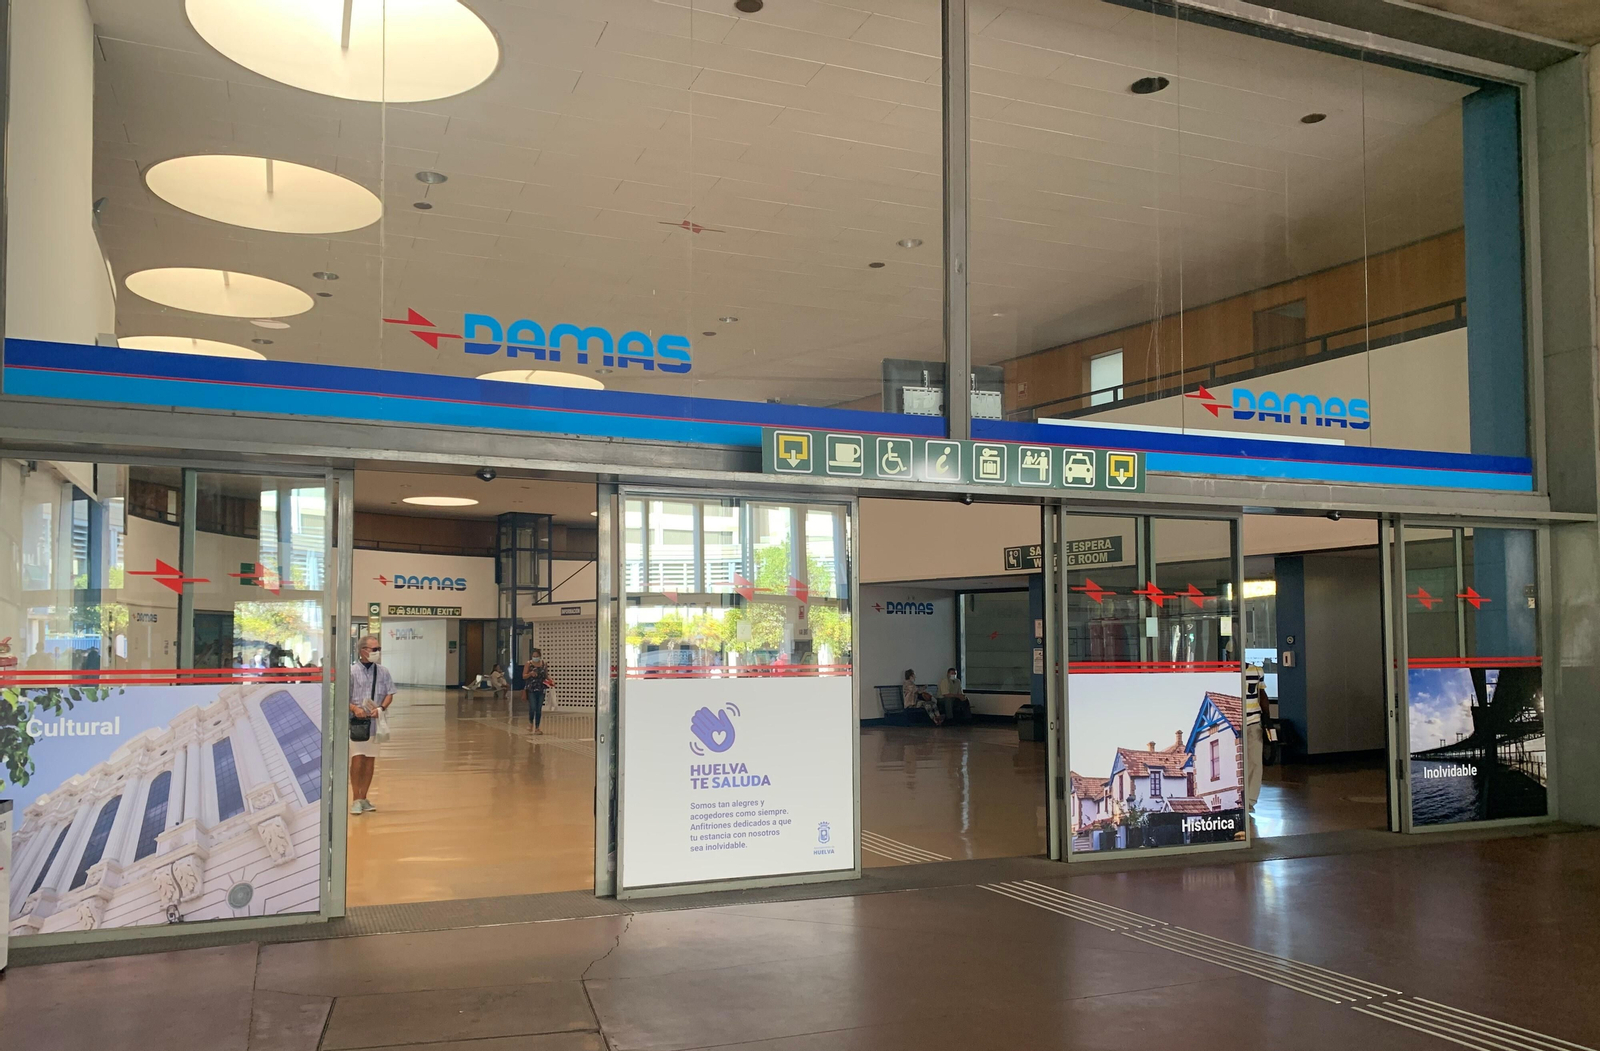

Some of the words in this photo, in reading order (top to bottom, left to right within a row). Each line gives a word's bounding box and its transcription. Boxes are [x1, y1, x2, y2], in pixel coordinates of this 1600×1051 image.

[464, 313, 692, 374] DAMAS
[1232, 388, 1371, 430] DAMAS
[1072, 538, 1112, 552] ESPERA
[1078, 552, 1108, 564] ROOM
[394, 574, 467, 591] DAMAS
[406, 607, 432, 615] SALIDA
[886, 601, 934, 615] DAMAS
[25, 715, 120, 738] Cultural
[690, 763, 748, 776] HUELVA
[1423, 763, 1478, 779] Inolvidable
[690, 777, 709, 789] TE
[712, 775, 771, 789] SALUDA
[690, 802, 716, 810] Somos
[731, 800, 759, 808] alegres
[690, 811, 734, 820] acogedores
[757, 808, 789, 816] siempre.
[690, 822, 732, 831] Anfitriones
[733, 818, 771, 828] dedicados
[778, 818, 792, 826] que
[1181, 816, 1235, 833] Histórica
[699, 832, 731, 840] estancia
[748, 829, 780, 837] nosotros
[705, 841, 748, 851] inolvidable.
